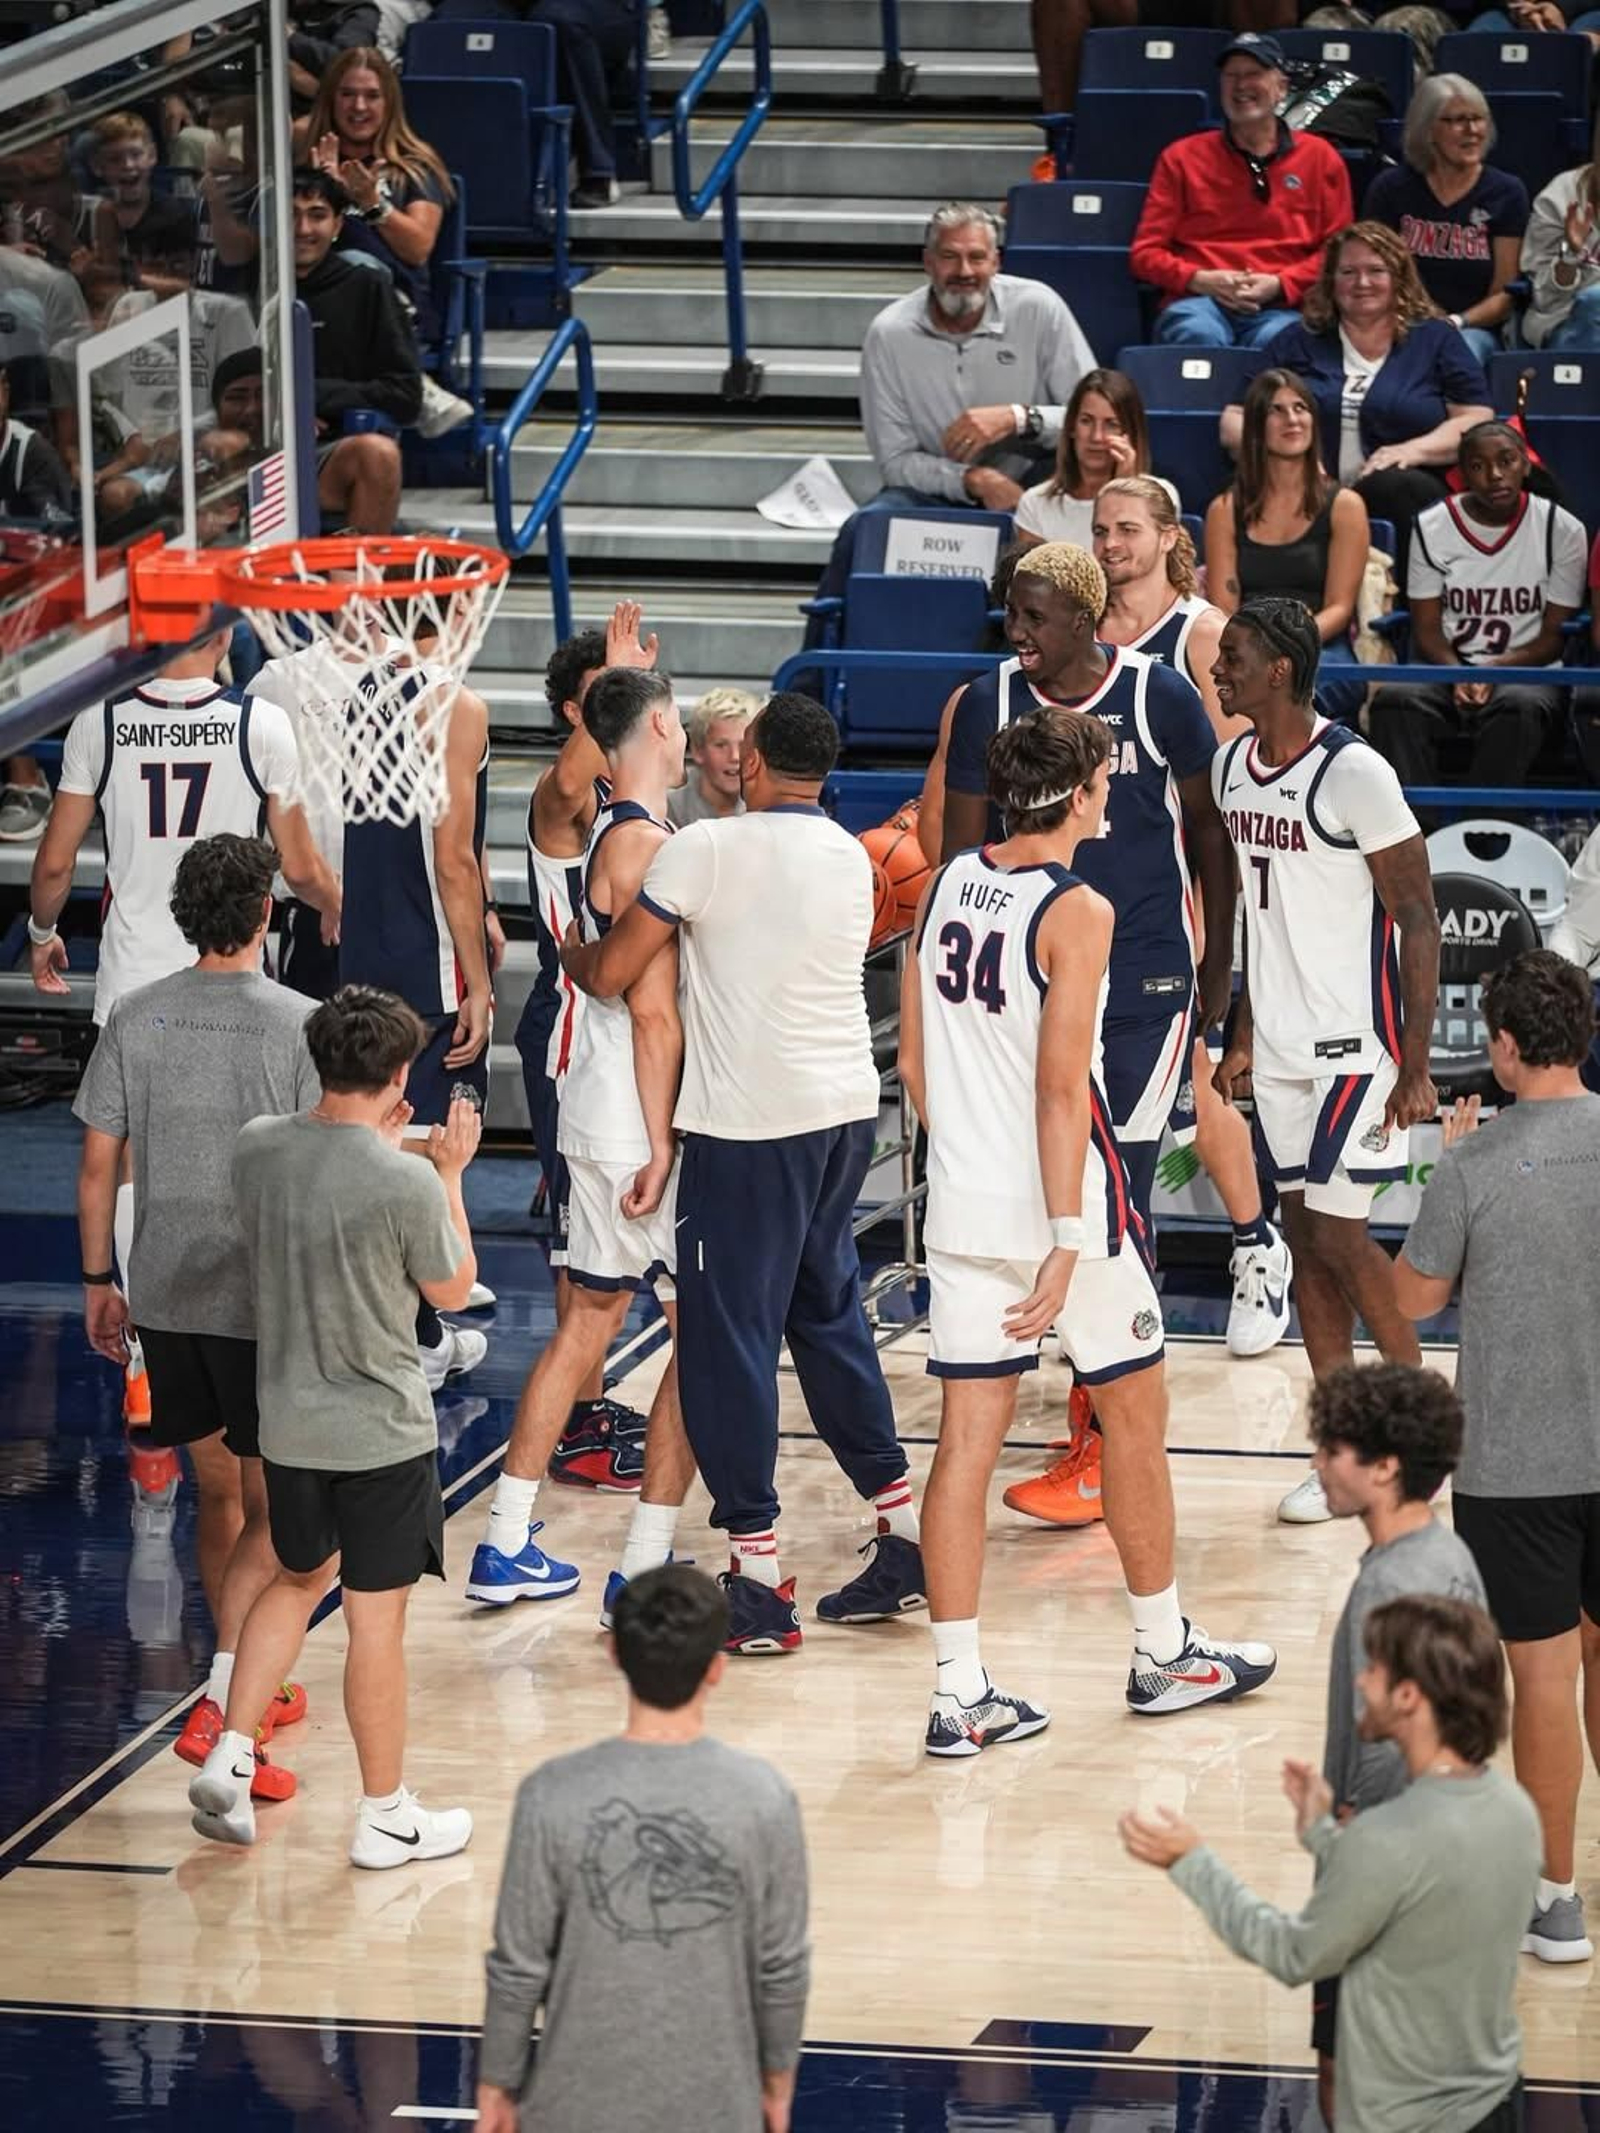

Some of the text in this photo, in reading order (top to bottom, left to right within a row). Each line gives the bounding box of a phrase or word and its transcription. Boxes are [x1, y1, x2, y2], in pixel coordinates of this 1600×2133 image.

[923, 537, 963, 553] ROW
[897, 560, 984, 577] RESERVED
[116, 715, 236, 747] SAINT-SUPÉRY
[1098, 714, 1123, 725] WCC
[140, 762, 212, 838] 17
[1279, 787, 1298, 801] WCC
[1250, 855, 1270, 910] 7
[960, 883, 1014, 915] HUFF
[936, 921, 1006, 1015] 34
